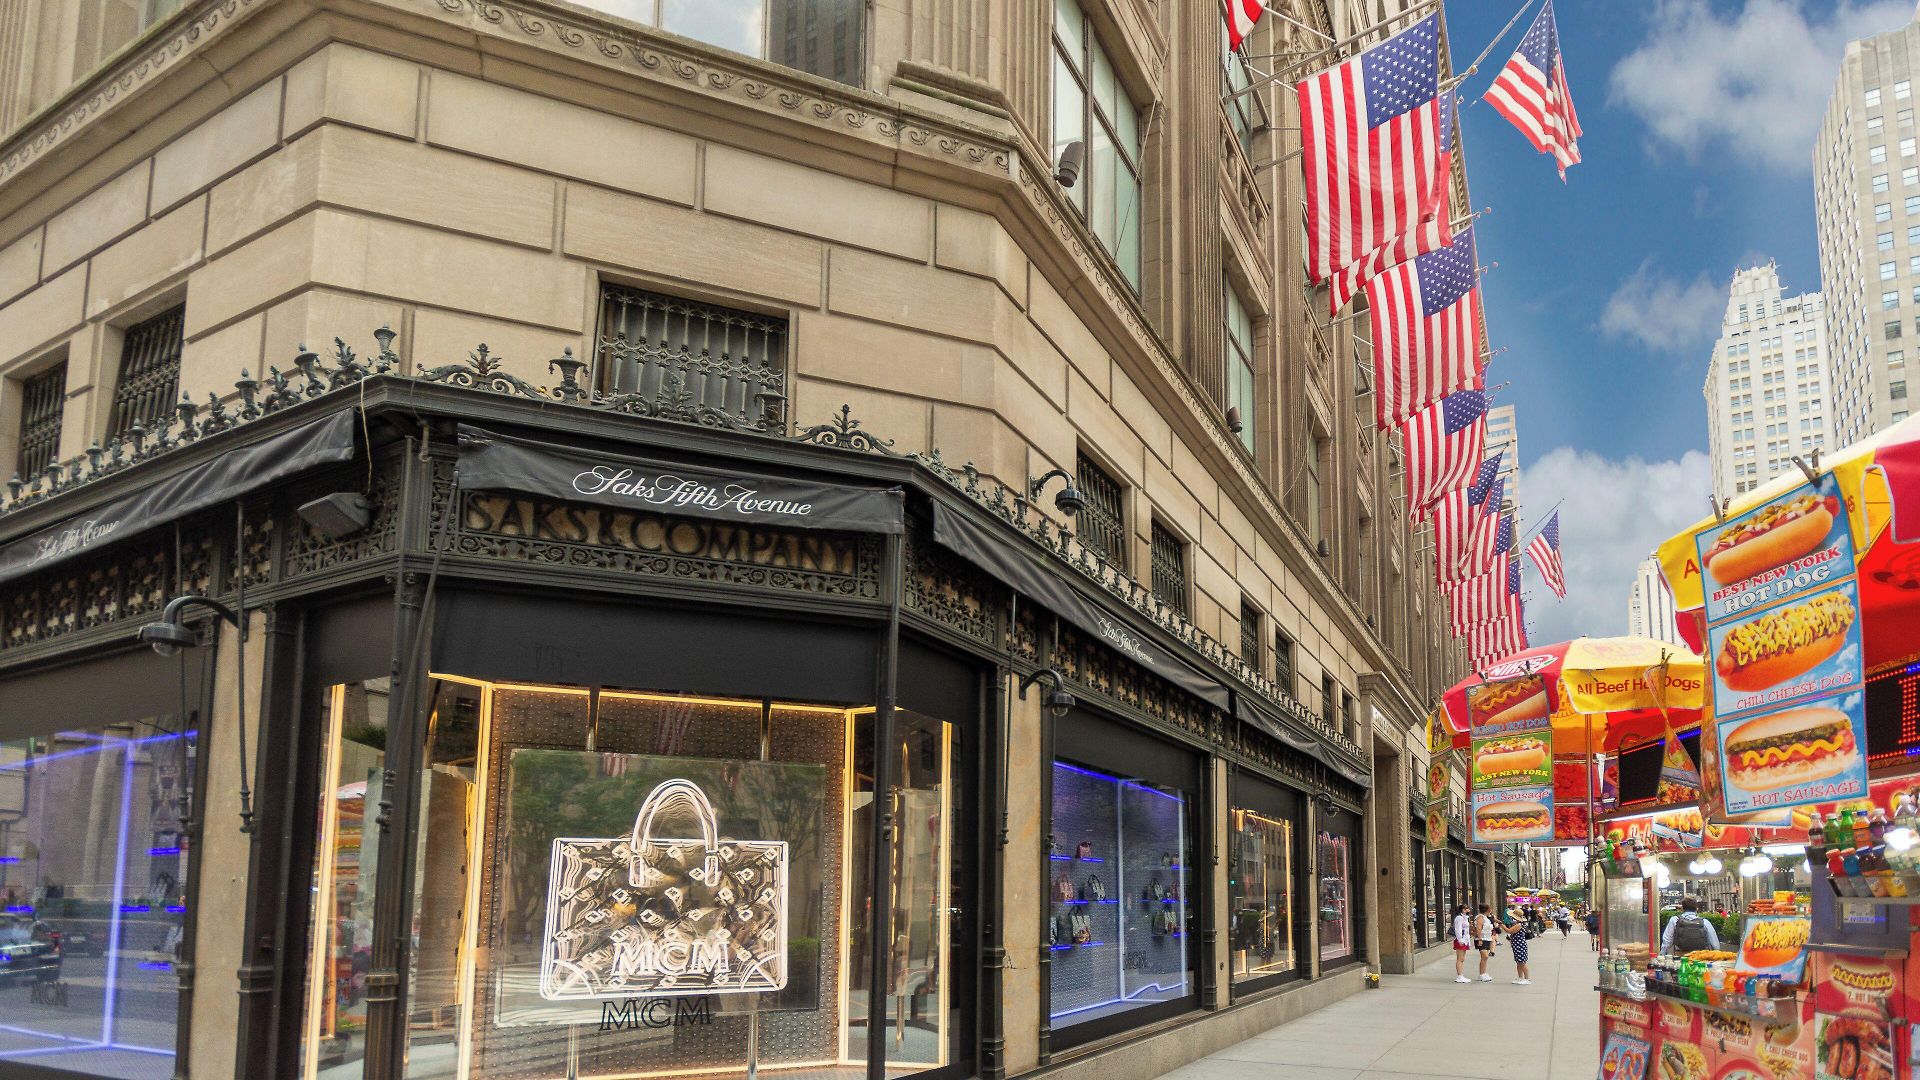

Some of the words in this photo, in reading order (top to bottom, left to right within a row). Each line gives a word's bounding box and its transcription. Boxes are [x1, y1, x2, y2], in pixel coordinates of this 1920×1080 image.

[573, 466, 655, 498] Saks
[645, 475, 718, 507] Fifth
[702, 484, 812, 515] Avenue
[465, 493, 588, 543] SAKS
[630, 517, 856, 574] COMPANY
[1712, 579, 1751, 601] BEST
[1751, 564, 1789, 588] NEW
[1789, 546, 1843, 573] YORK
[1724, 585, 1771, 614] HOT
[1775, 565, 1831, 596] DOG
[1577, 683, 1592, 695] All
[1596, 678, 1630, 695] Beef
[1736, 694, 1765, 710] CHILI
[1767, 680, 1818, 702] CHEESE
[1820, 672, 1853, 689] DOG
[1475, 772, 1498, 783] BEST
[1500, 769, 1520, 777] NEW
[1523, 769, 1548, 777] YORK
[1476, 794, 1496, 802] Hot
[1500, 789, 1550, 801] Sausage
[1752, 792, 1781, 807] HOT
[1784, 780, 1860, 803] SAUSAGE
[610, 941, 731, 975] MCM
[599, 997, 712, 1031] MCM
